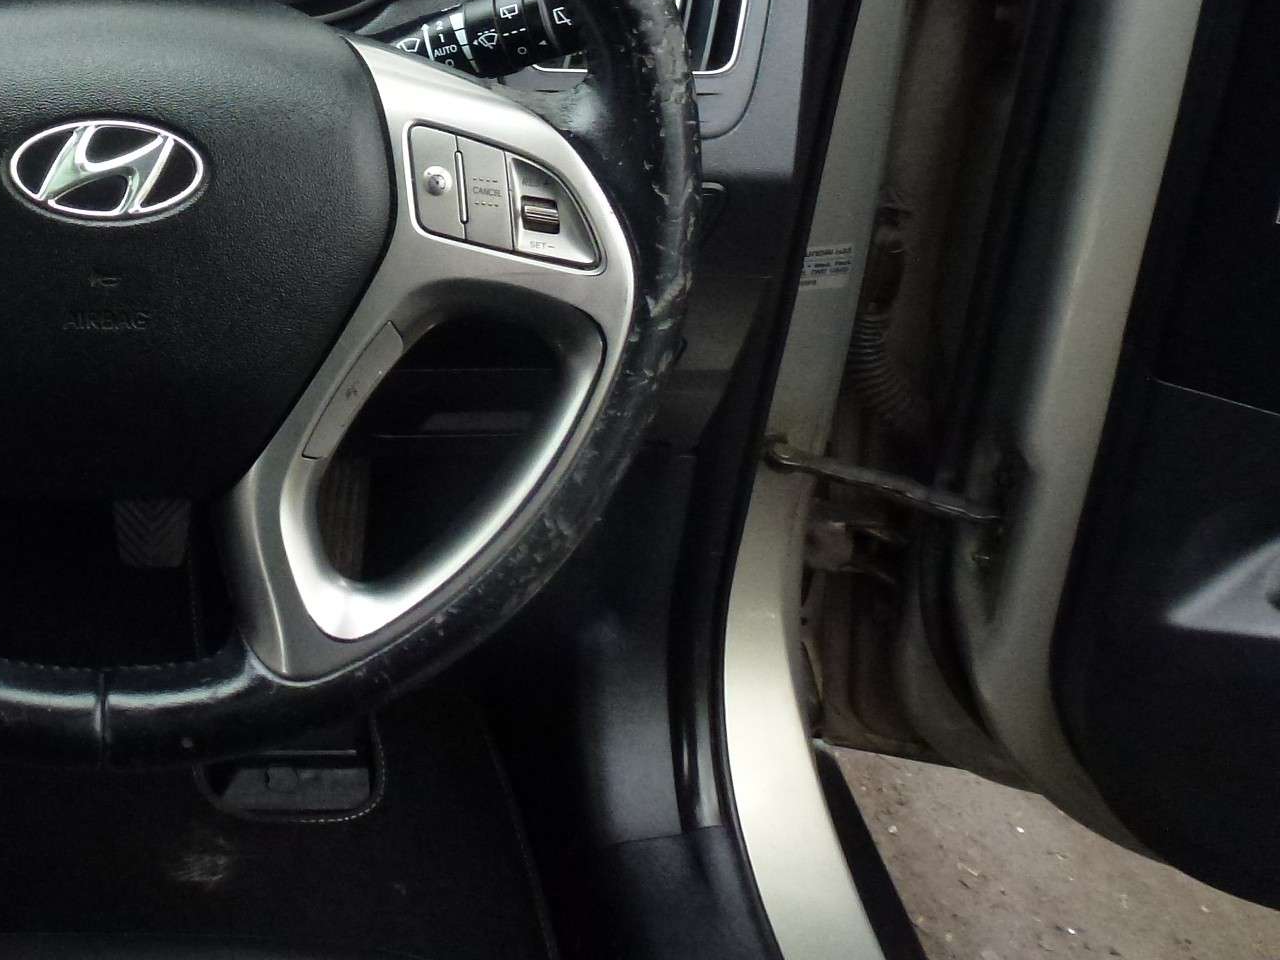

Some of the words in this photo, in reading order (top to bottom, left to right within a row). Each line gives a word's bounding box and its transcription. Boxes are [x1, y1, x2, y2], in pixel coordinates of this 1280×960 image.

[436, 20, 443, 30] 2
[438, 33, 445, 43] 1
[434, 45, 458, 58] AUTO
[473, 187, 502, 198] CANCEL
